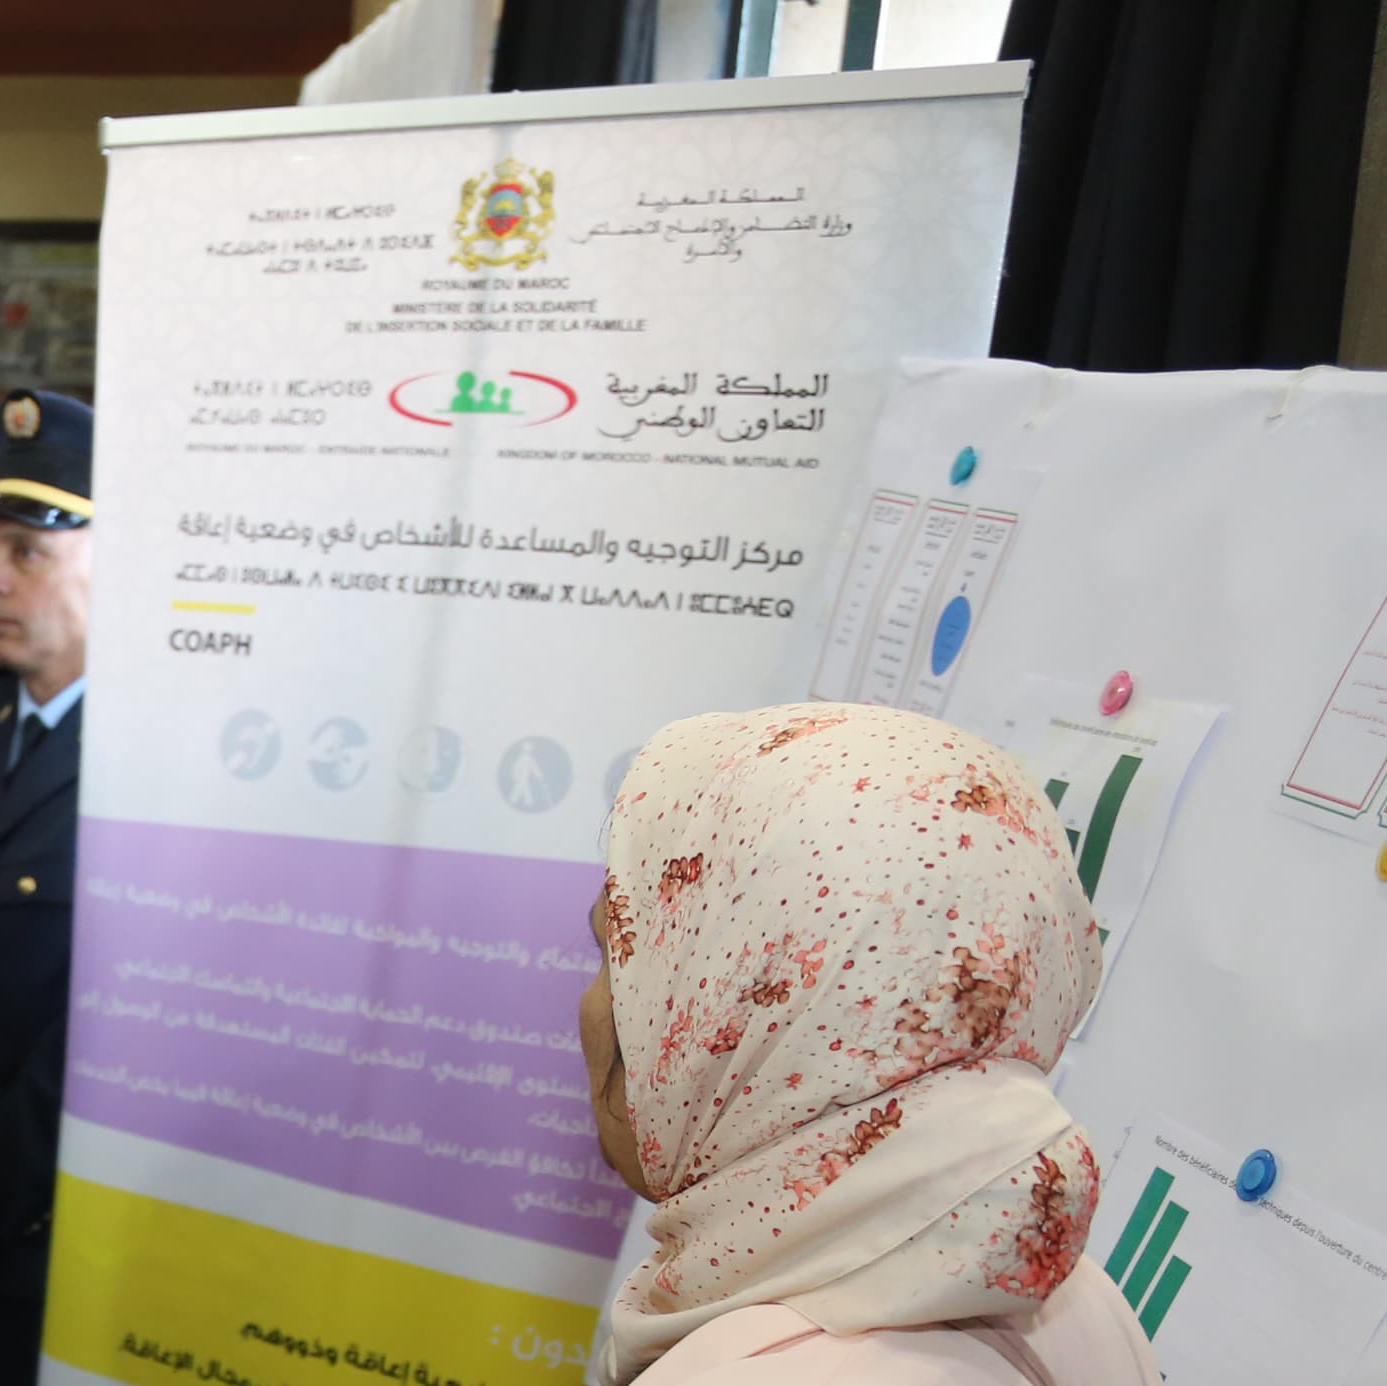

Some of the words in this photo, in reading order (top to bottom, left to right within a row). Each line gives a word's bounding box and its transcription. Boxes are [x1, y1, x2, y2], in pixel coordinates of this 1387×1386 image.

[636, 189, 717, 214] المغربية
[719, 187, 807, 204] المملكة
[517, 277, 570, 291] MAROC
[606, 372, 699, 407] المغربية
[715, 373, 830, 399] المملكة
[597, 405, 716, 441] الوطني
[717, 407, 826, 442] التعاون
[177, 511, 232, 544] إعاقة
[234, 515, 314, 549] وضعية
[317, 516, 357, 554] في
[359, 515, 476, 551] للأشخاص
[479, 526, 620, 563] والمساعدة
[626, 533, 729, 568] التوجيه
[731, 540, 804, 573] مركز
[169, 627, 253, 657] COAPH
[344, 1341, 411, 1386] إعاقة
